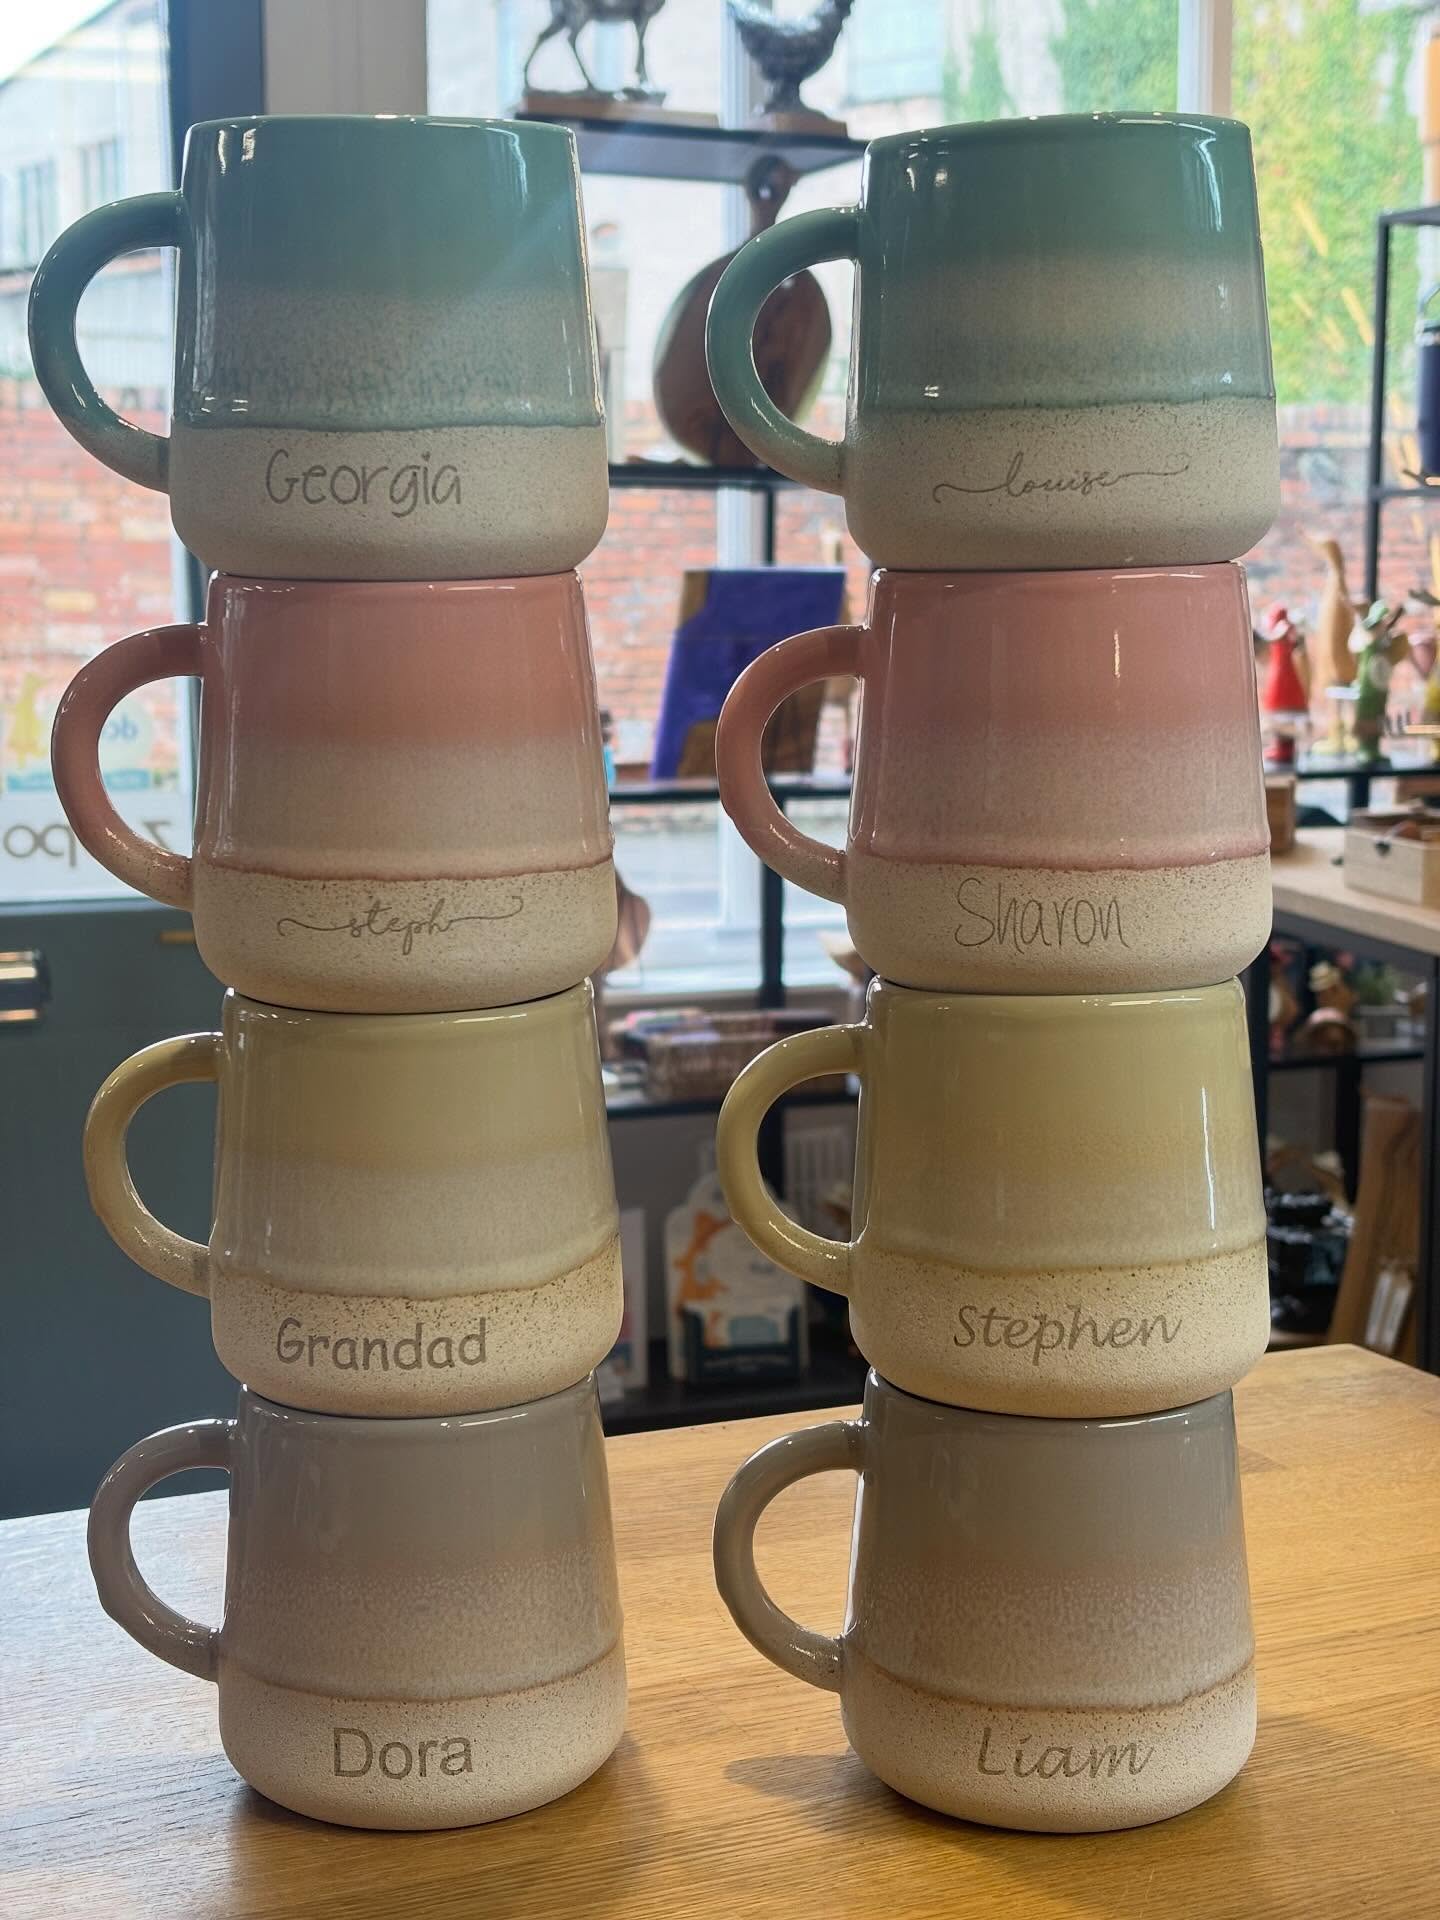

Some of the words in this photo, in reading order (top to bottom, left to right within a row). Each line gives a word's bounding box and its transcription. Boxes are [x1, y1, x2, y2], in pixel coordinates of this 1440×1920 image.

[265, 448, 461, 518] Georgia
[276, 896, 524, 956] steph
[954, 877, 1130, 954] Sharon
[276, 1316, 487, 1371] Grandad
[953, 1303, 1182, 1366] Stephen
[332, 1727, 473, 1779] Dora
[976, 1726, 1154, 1779] Liam
